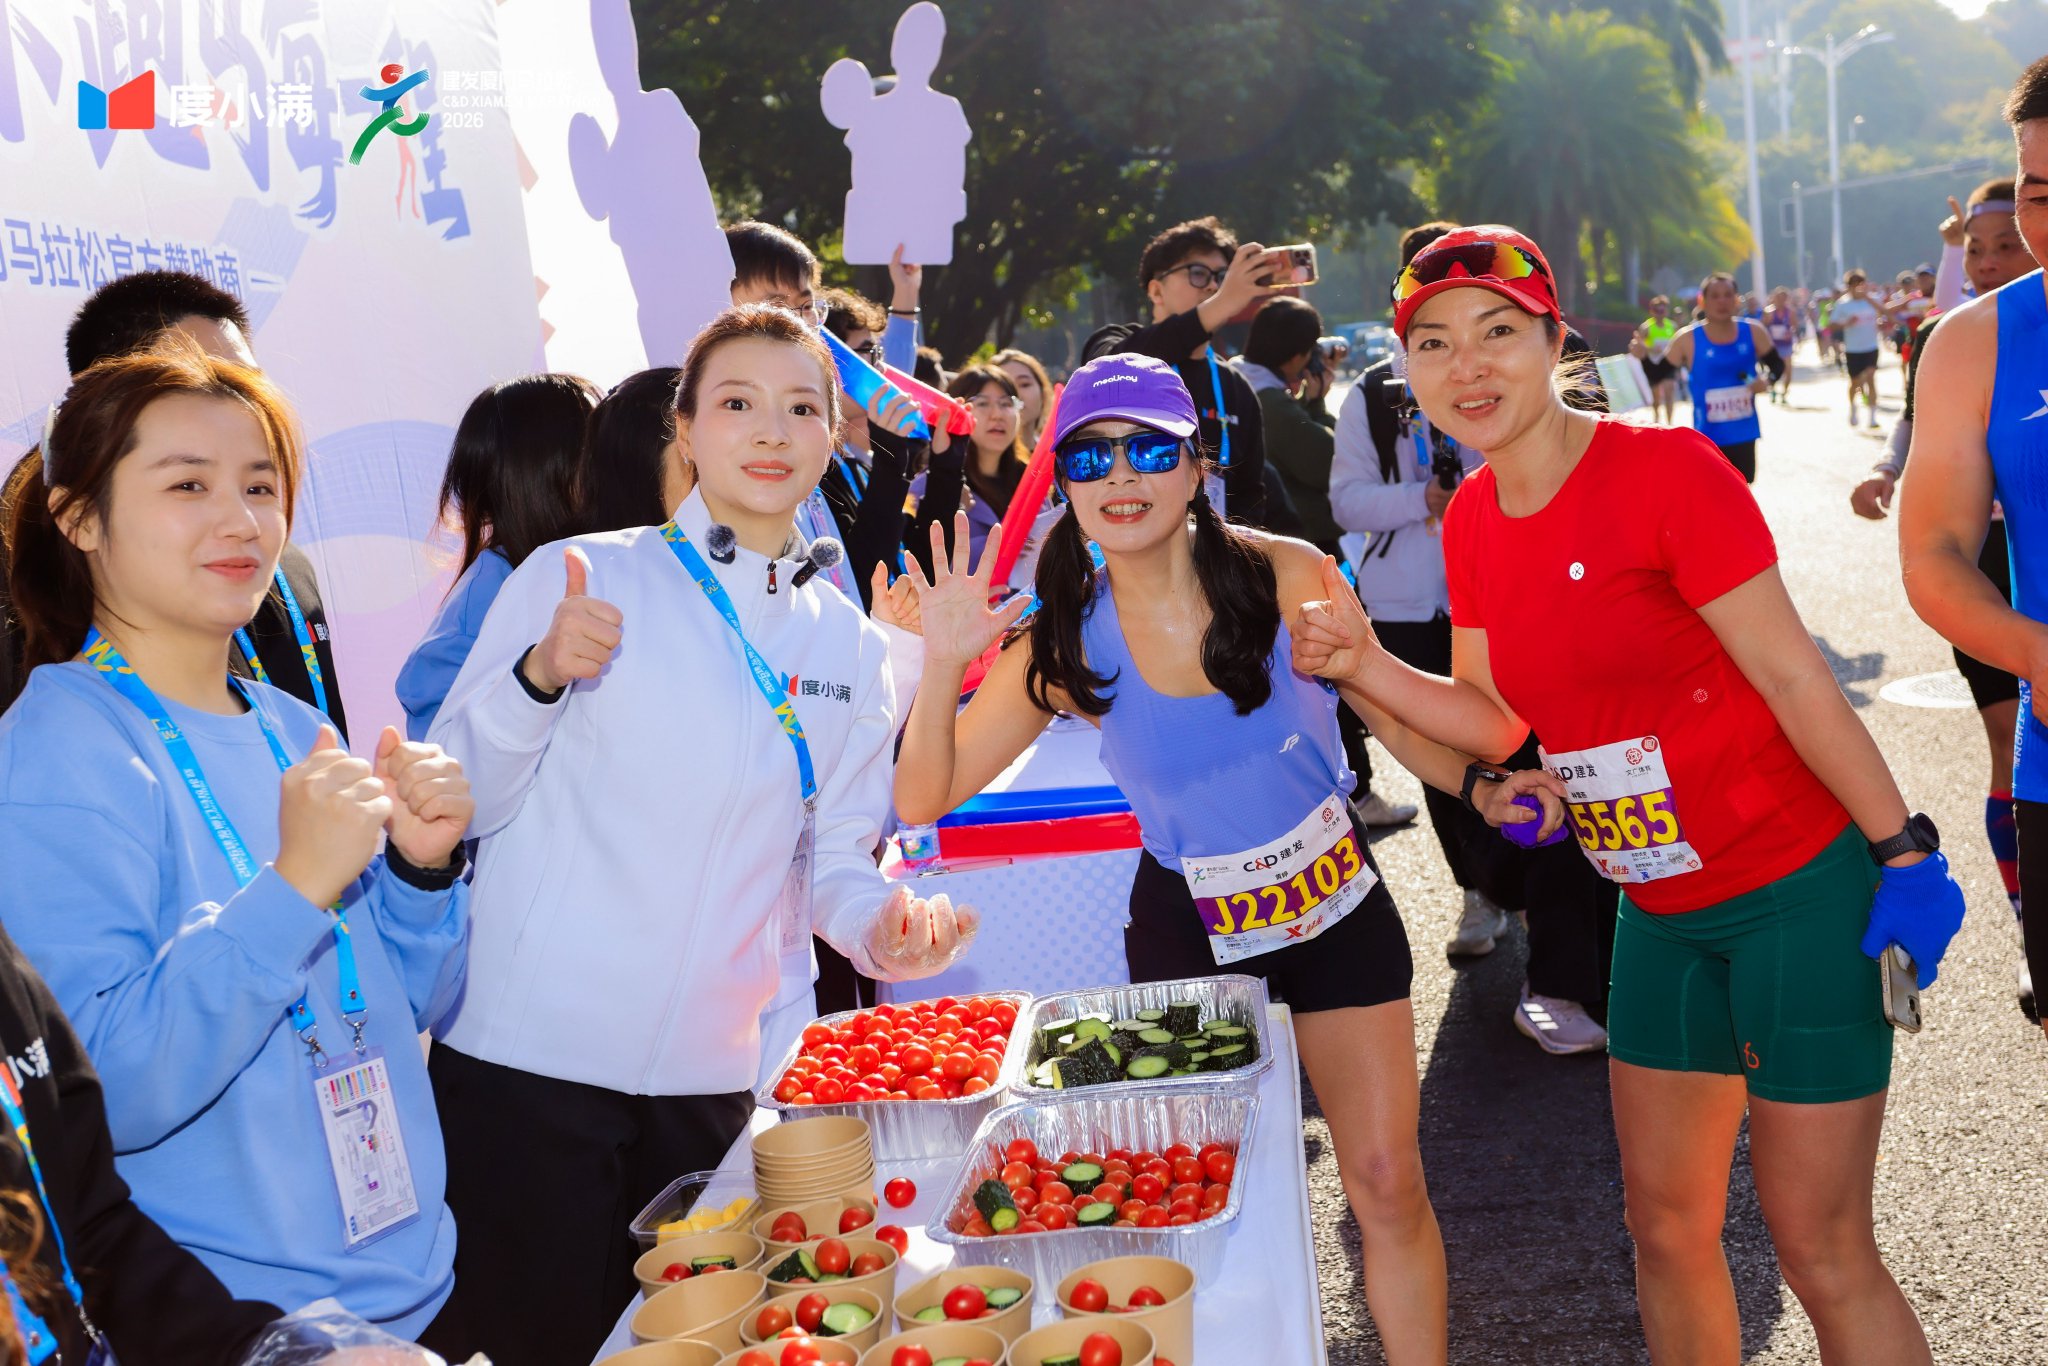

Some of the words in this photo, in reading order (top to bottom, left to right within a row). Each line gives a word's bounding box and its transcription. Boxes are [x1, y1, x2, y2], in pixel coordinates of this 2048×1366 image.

[0, 217, 244, 301] 马拉松官方赞助商
[801, 679, 852, 703] 度小满
[1574, 764, 1598, 779] 建发
[1568, 791, 1679, 851] 5565
[1243, 854, 1279, 873] C&D
[1279, 839, 1305, 861] 建发
[1212, 836, 1361, 936] J22103
